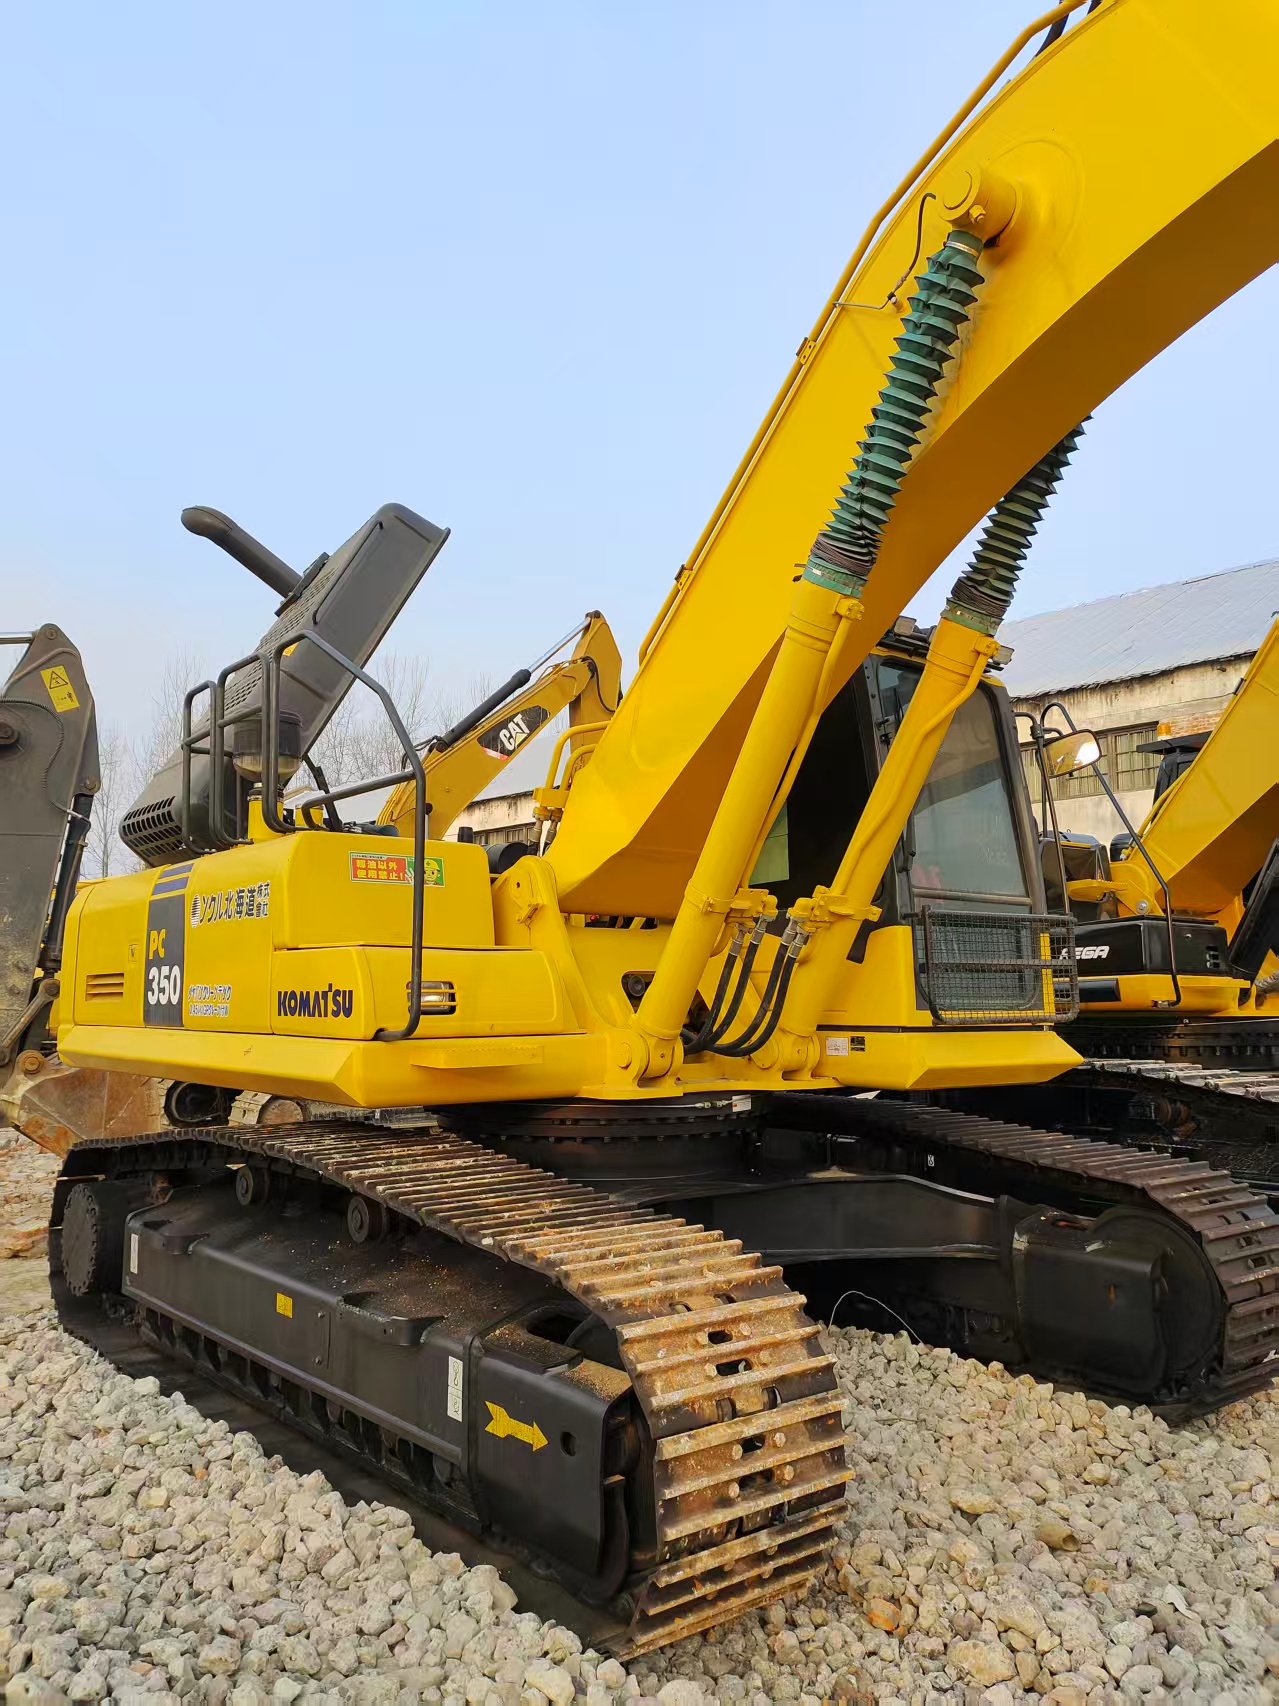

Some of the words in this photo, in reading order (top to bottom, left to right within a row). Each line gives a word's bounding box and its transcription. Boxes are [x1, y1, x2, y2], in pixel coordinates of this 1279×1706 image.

[499, 713, 530, 751] CAT
[148, 929, 166, 960] PC
[147, 965, 181, 1006] 350
[277, 983, 354, 1019] KOMATSU
